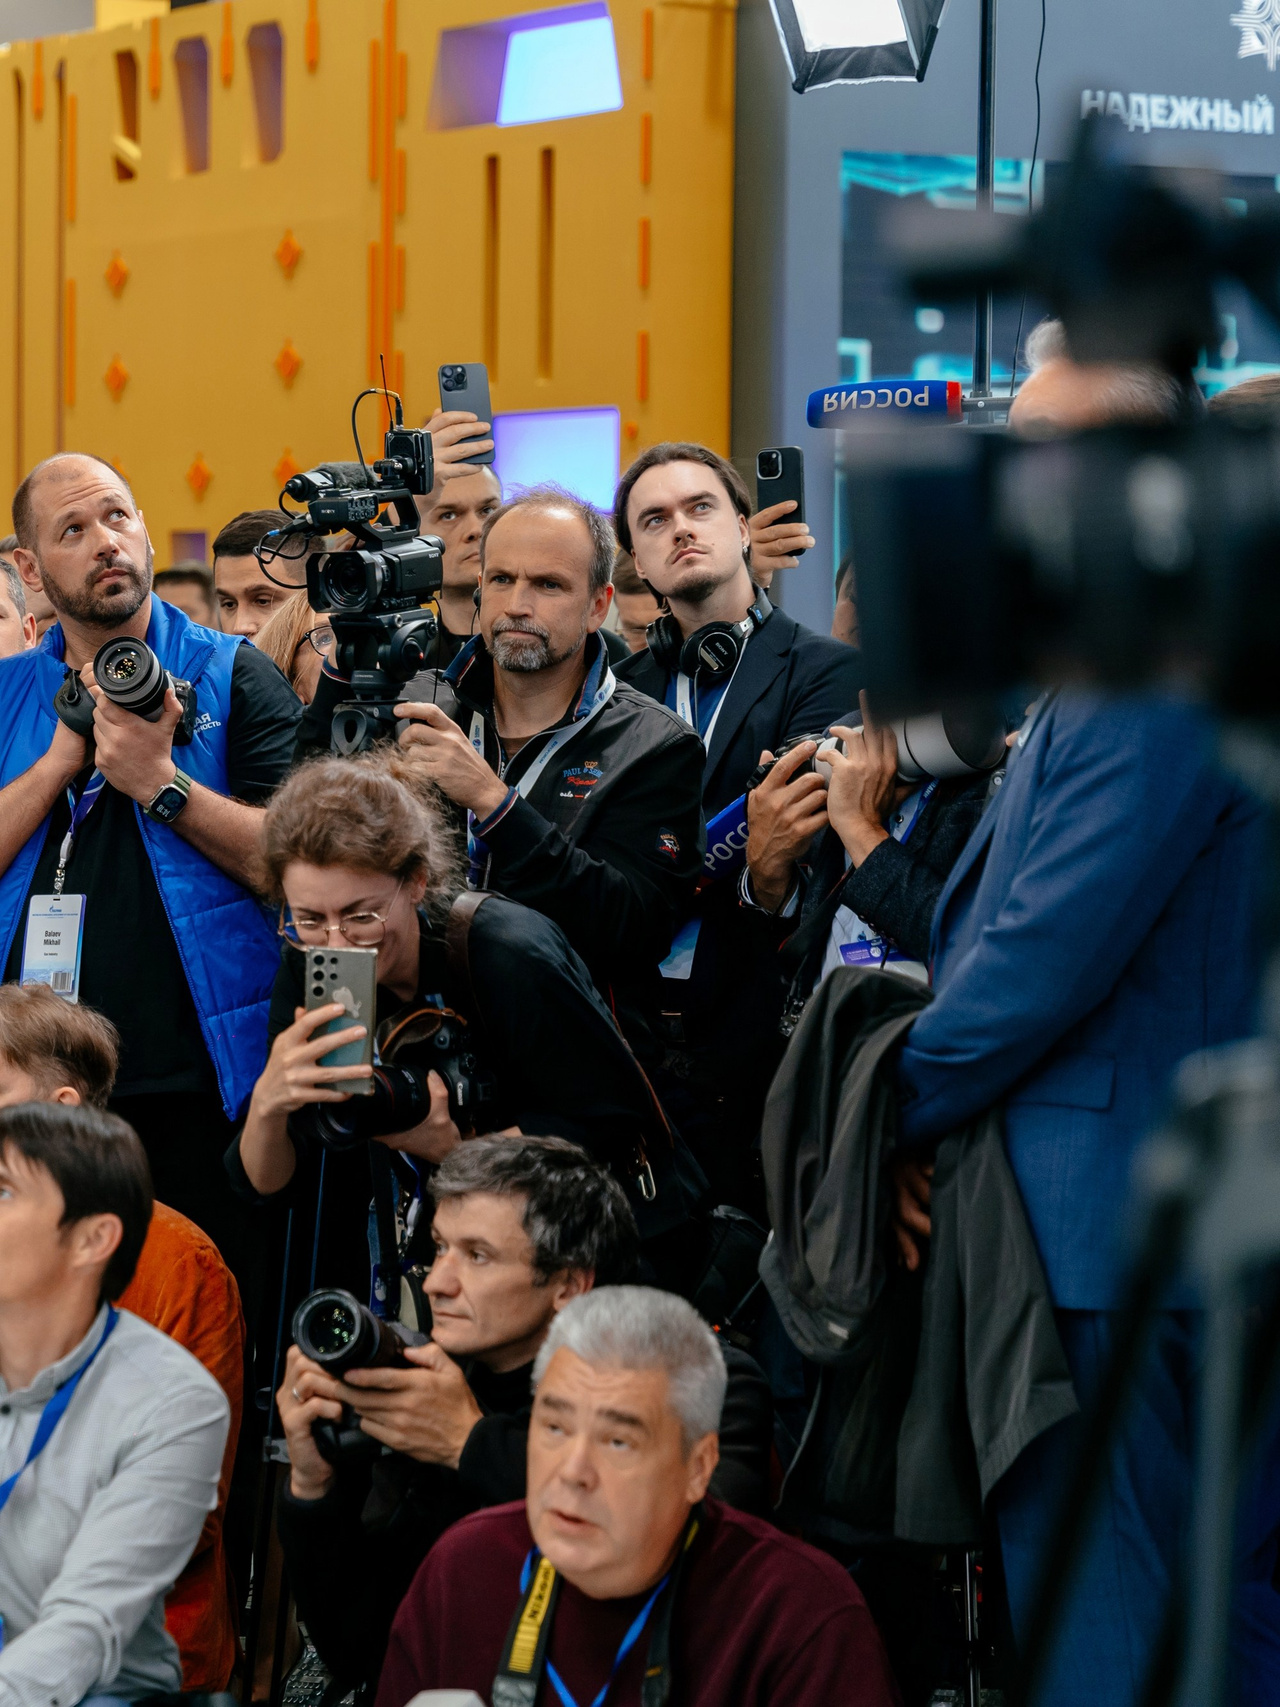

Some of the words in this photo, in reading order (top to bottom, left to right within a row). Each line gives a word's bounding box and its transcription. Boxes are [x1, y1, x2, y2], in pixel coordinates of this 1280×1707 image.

[1081, 89, 1275, 134] НАДЕЖНЫЙ
[823, 386, 929, 412] РОССИЯ
[715, 642, 729, 655] SONY
[563, 767, 581, 778] PAUL
[703, 821, 748, 871] РОСС
[44, 930, 62, 938] Balaev
